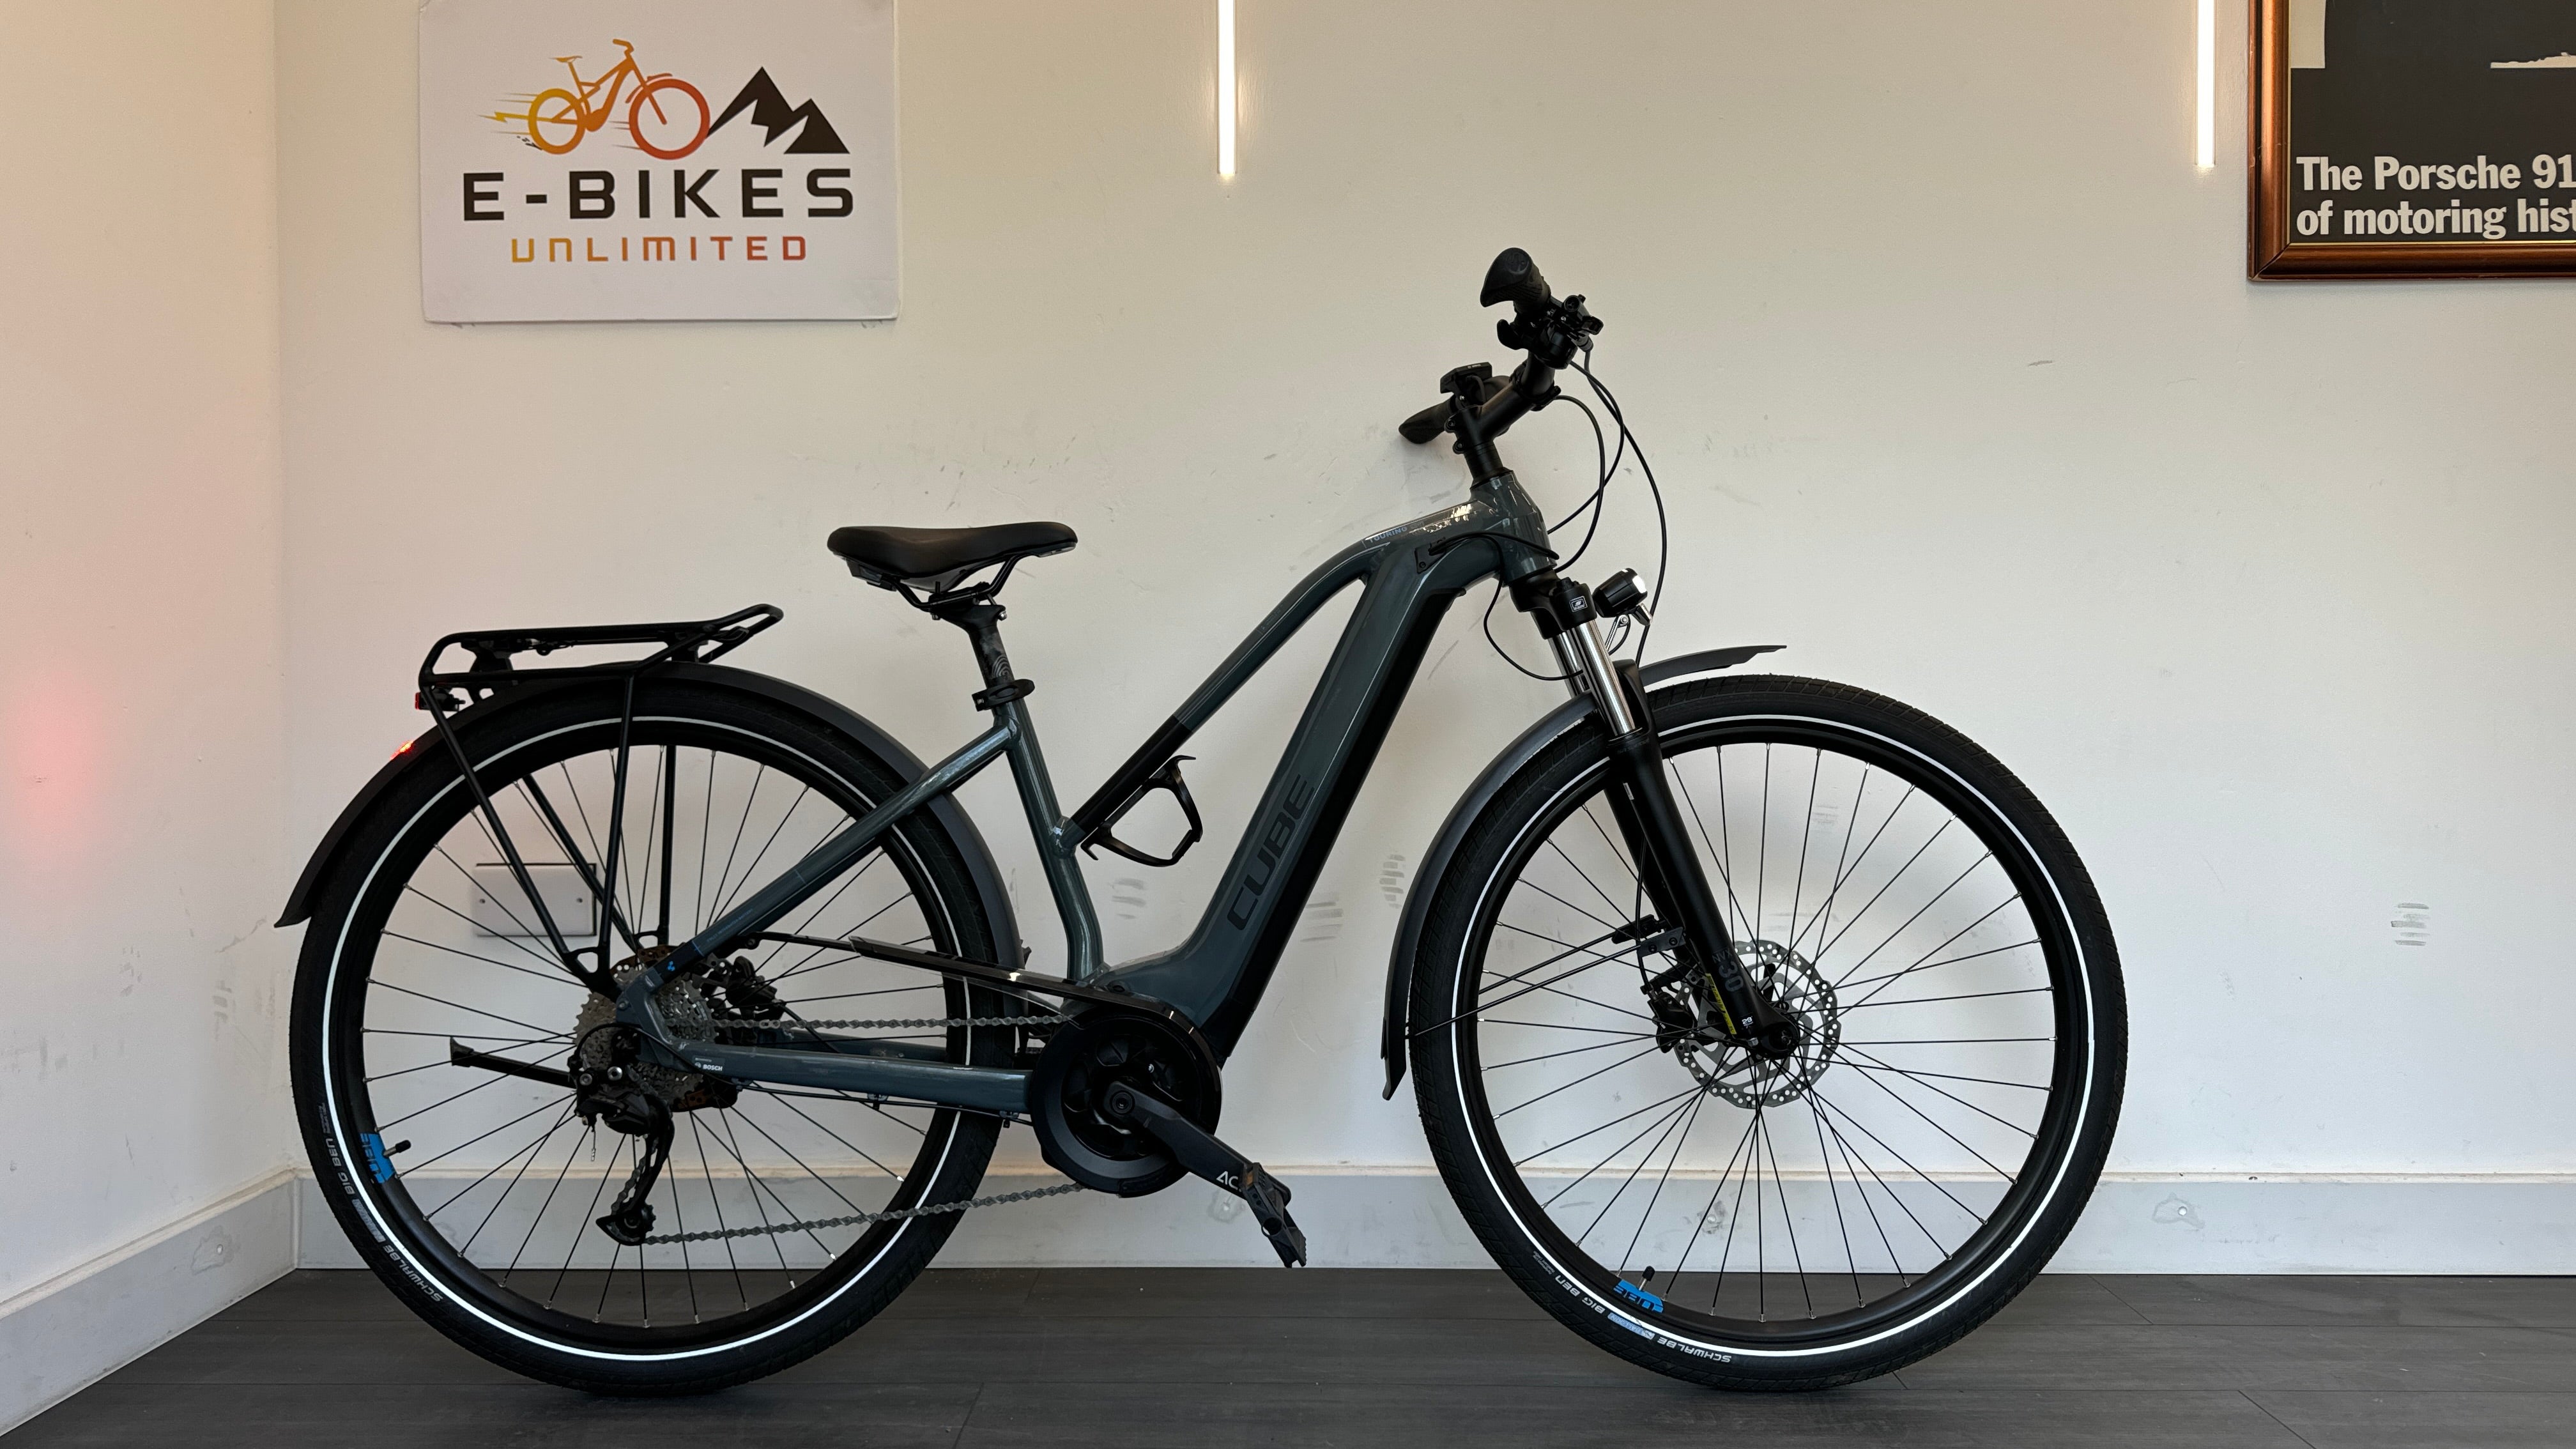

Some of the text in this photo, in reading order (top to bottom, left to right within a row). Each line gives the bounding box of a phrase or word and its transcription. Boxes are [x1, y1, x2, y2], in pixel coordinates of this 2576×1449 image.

[2296, 157, 2363, 190] The
[2374, 155, 2521, 190] Porsche
[463, 169, 854, 220] E-BIKES
[2297, 200, 2333, 235] of
[2344, 199, 2507, 239] motoring
[511, 236, 806, 263] UNLIMITED
[1227, 774, 1315, 931] CUBE
[1719, 960, 1744, 992] 30
[1216, 1170, 1242, 1193] AC
[325, 1138, 443, 1302] SCHWALBE BIG BEN
[1554, 1275, 1581, 1297] BEN
[1581, 1296, 1606, 1314] BIG
[1657, 1336, 1732, 1363] SCHWALBE
